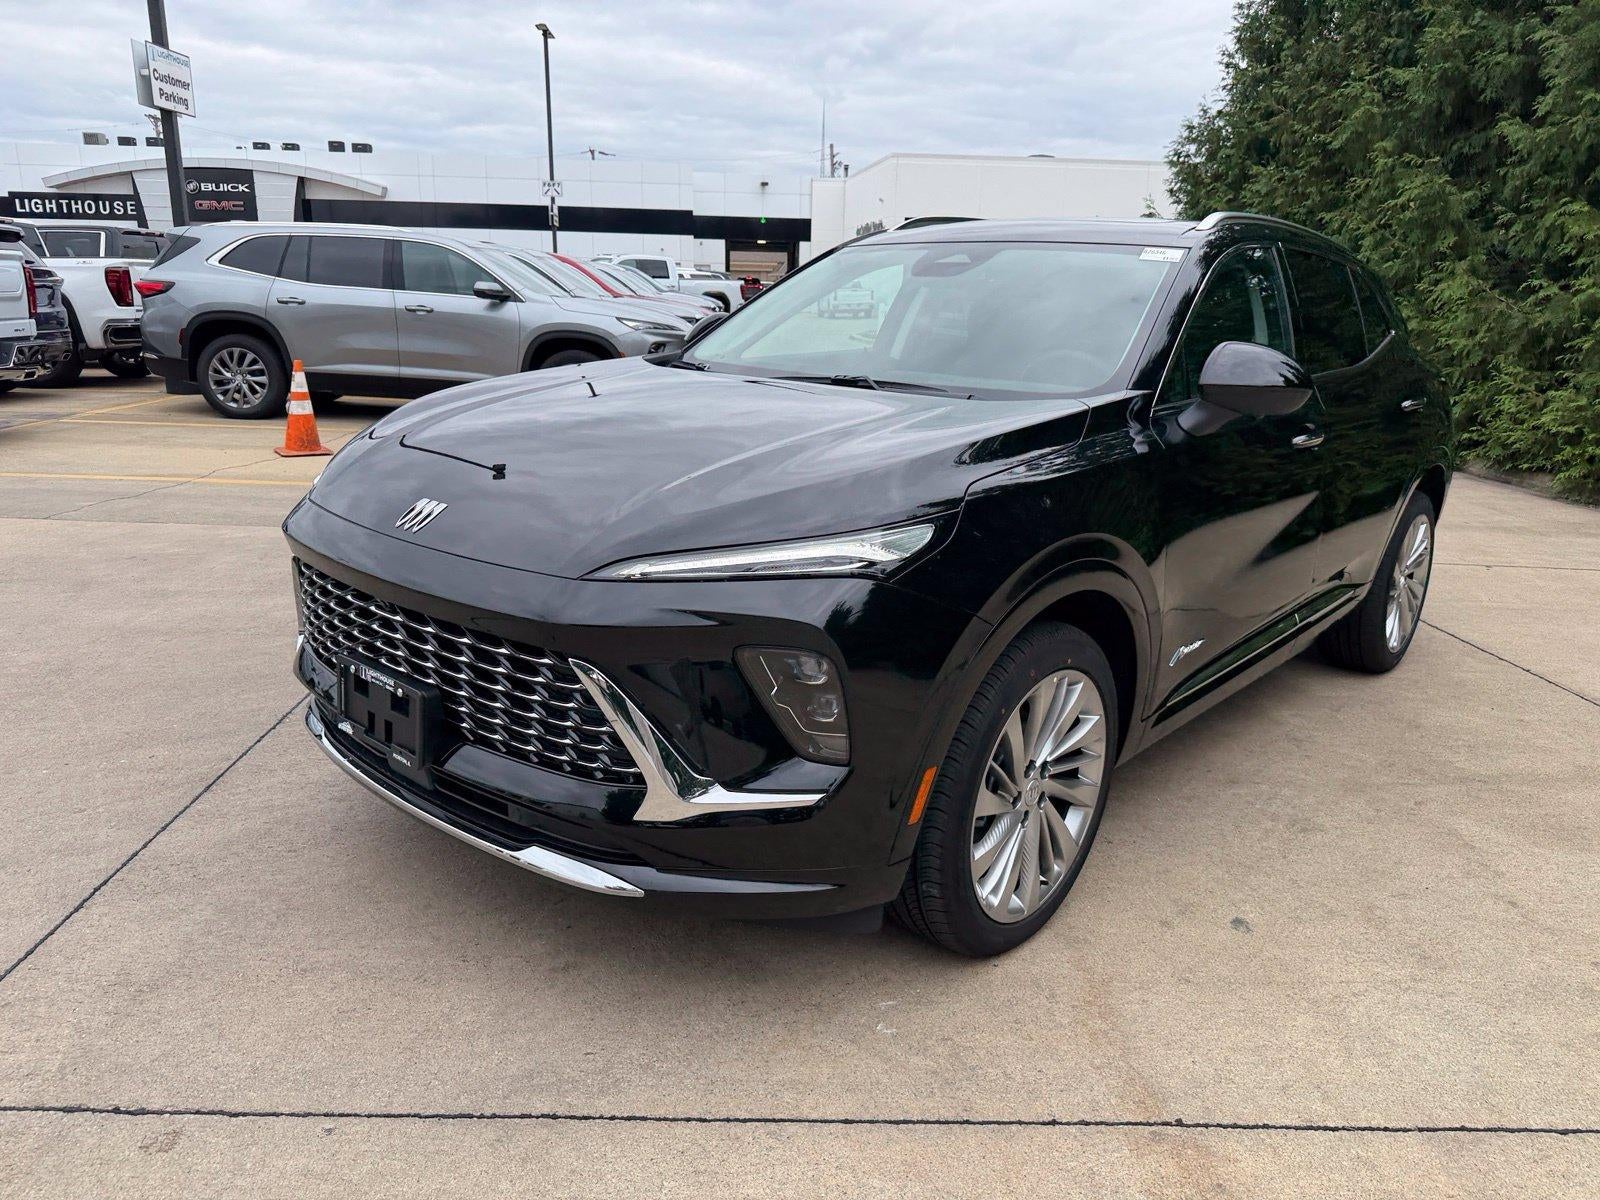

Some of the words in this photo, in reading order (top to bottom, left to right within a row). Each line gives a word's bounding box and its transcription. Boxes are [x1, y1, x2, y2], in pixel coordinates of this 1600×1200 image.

[152, 67, 190, 91] Customer
[158, 87, 190, 111] Parking
[200, 183, 250, 193] BUICK
[14, 198, 138, 216] LIGHTHOUSE
[194, 200, 244, 211] GMC
